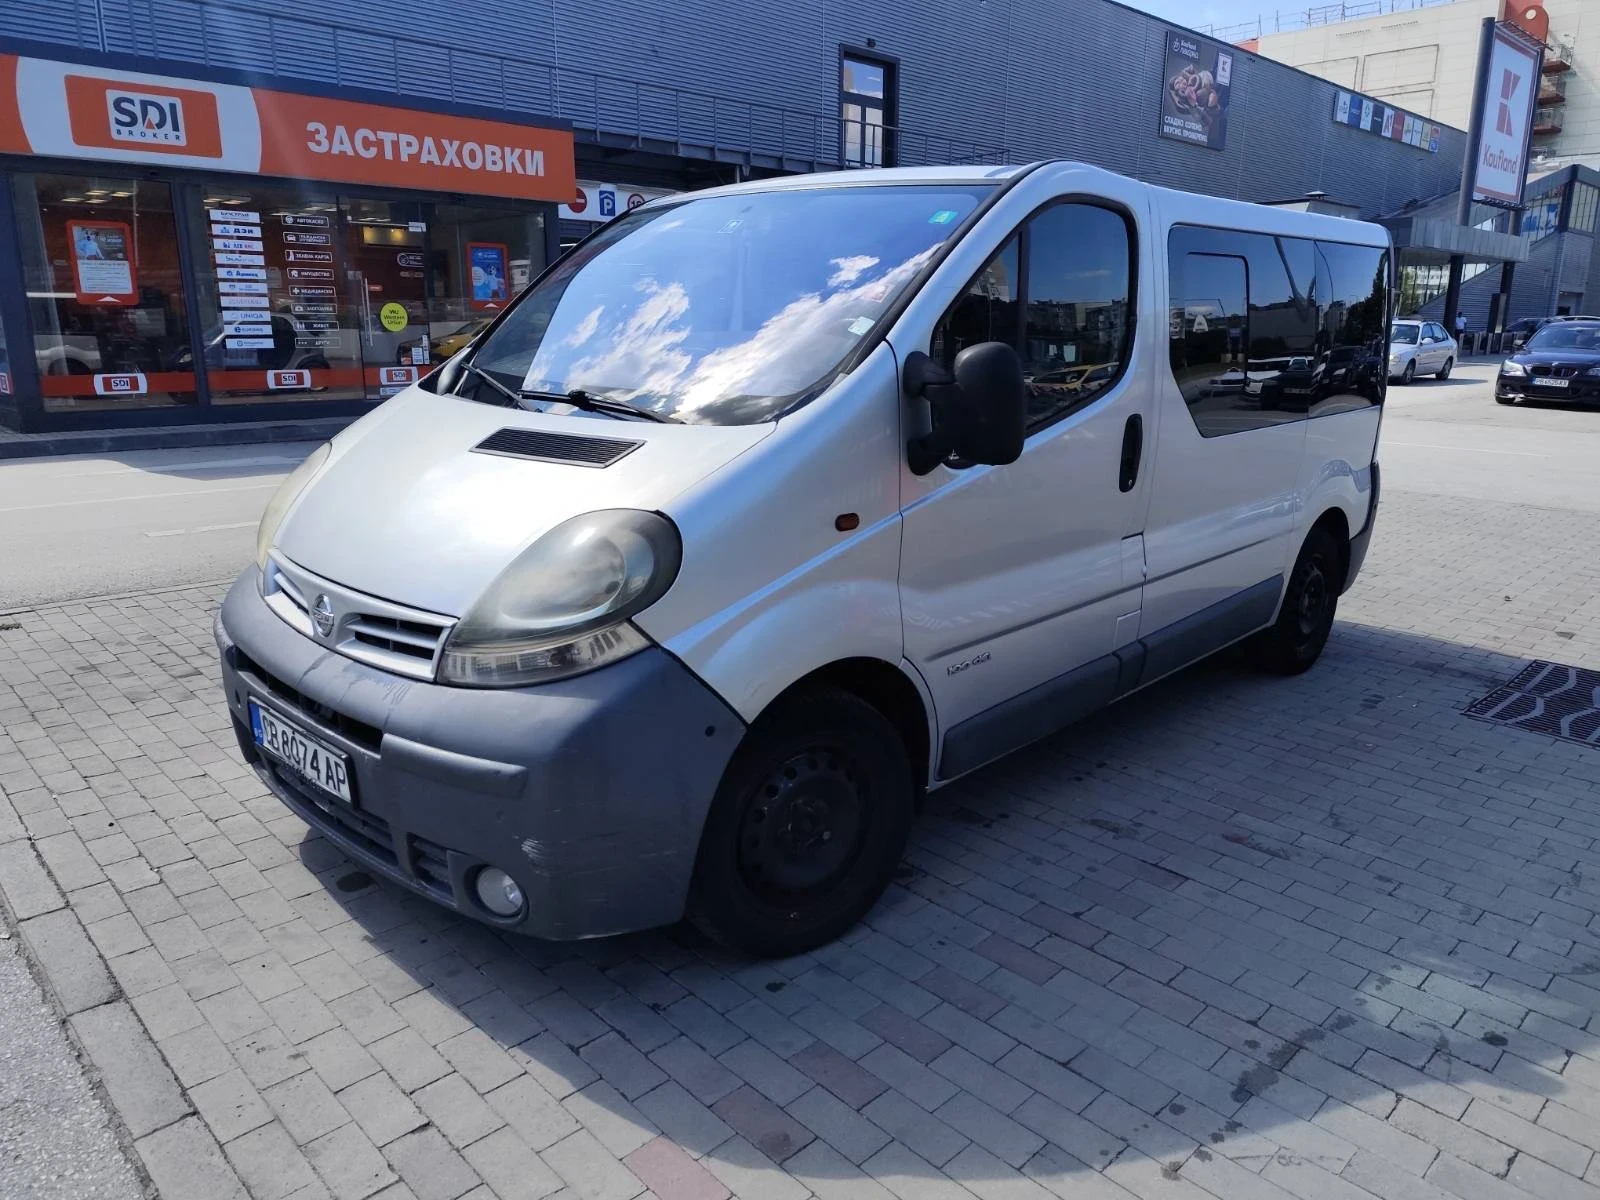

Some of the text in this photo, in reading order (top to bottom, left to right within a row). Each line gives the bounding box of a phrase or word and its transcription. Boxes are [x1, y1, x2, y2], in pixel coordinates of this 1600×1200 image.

[112, 96, 180, 132] SDI
[116, 129, 181, 141] BROKER
[306, 121, 545, 177] ЗАСТРАХОВКИ
[1482, 143, 1519, 174] Kaufland
[112, 379, 129, 387] SDI
[262, 714, 346, 793] CB 8074 AP
